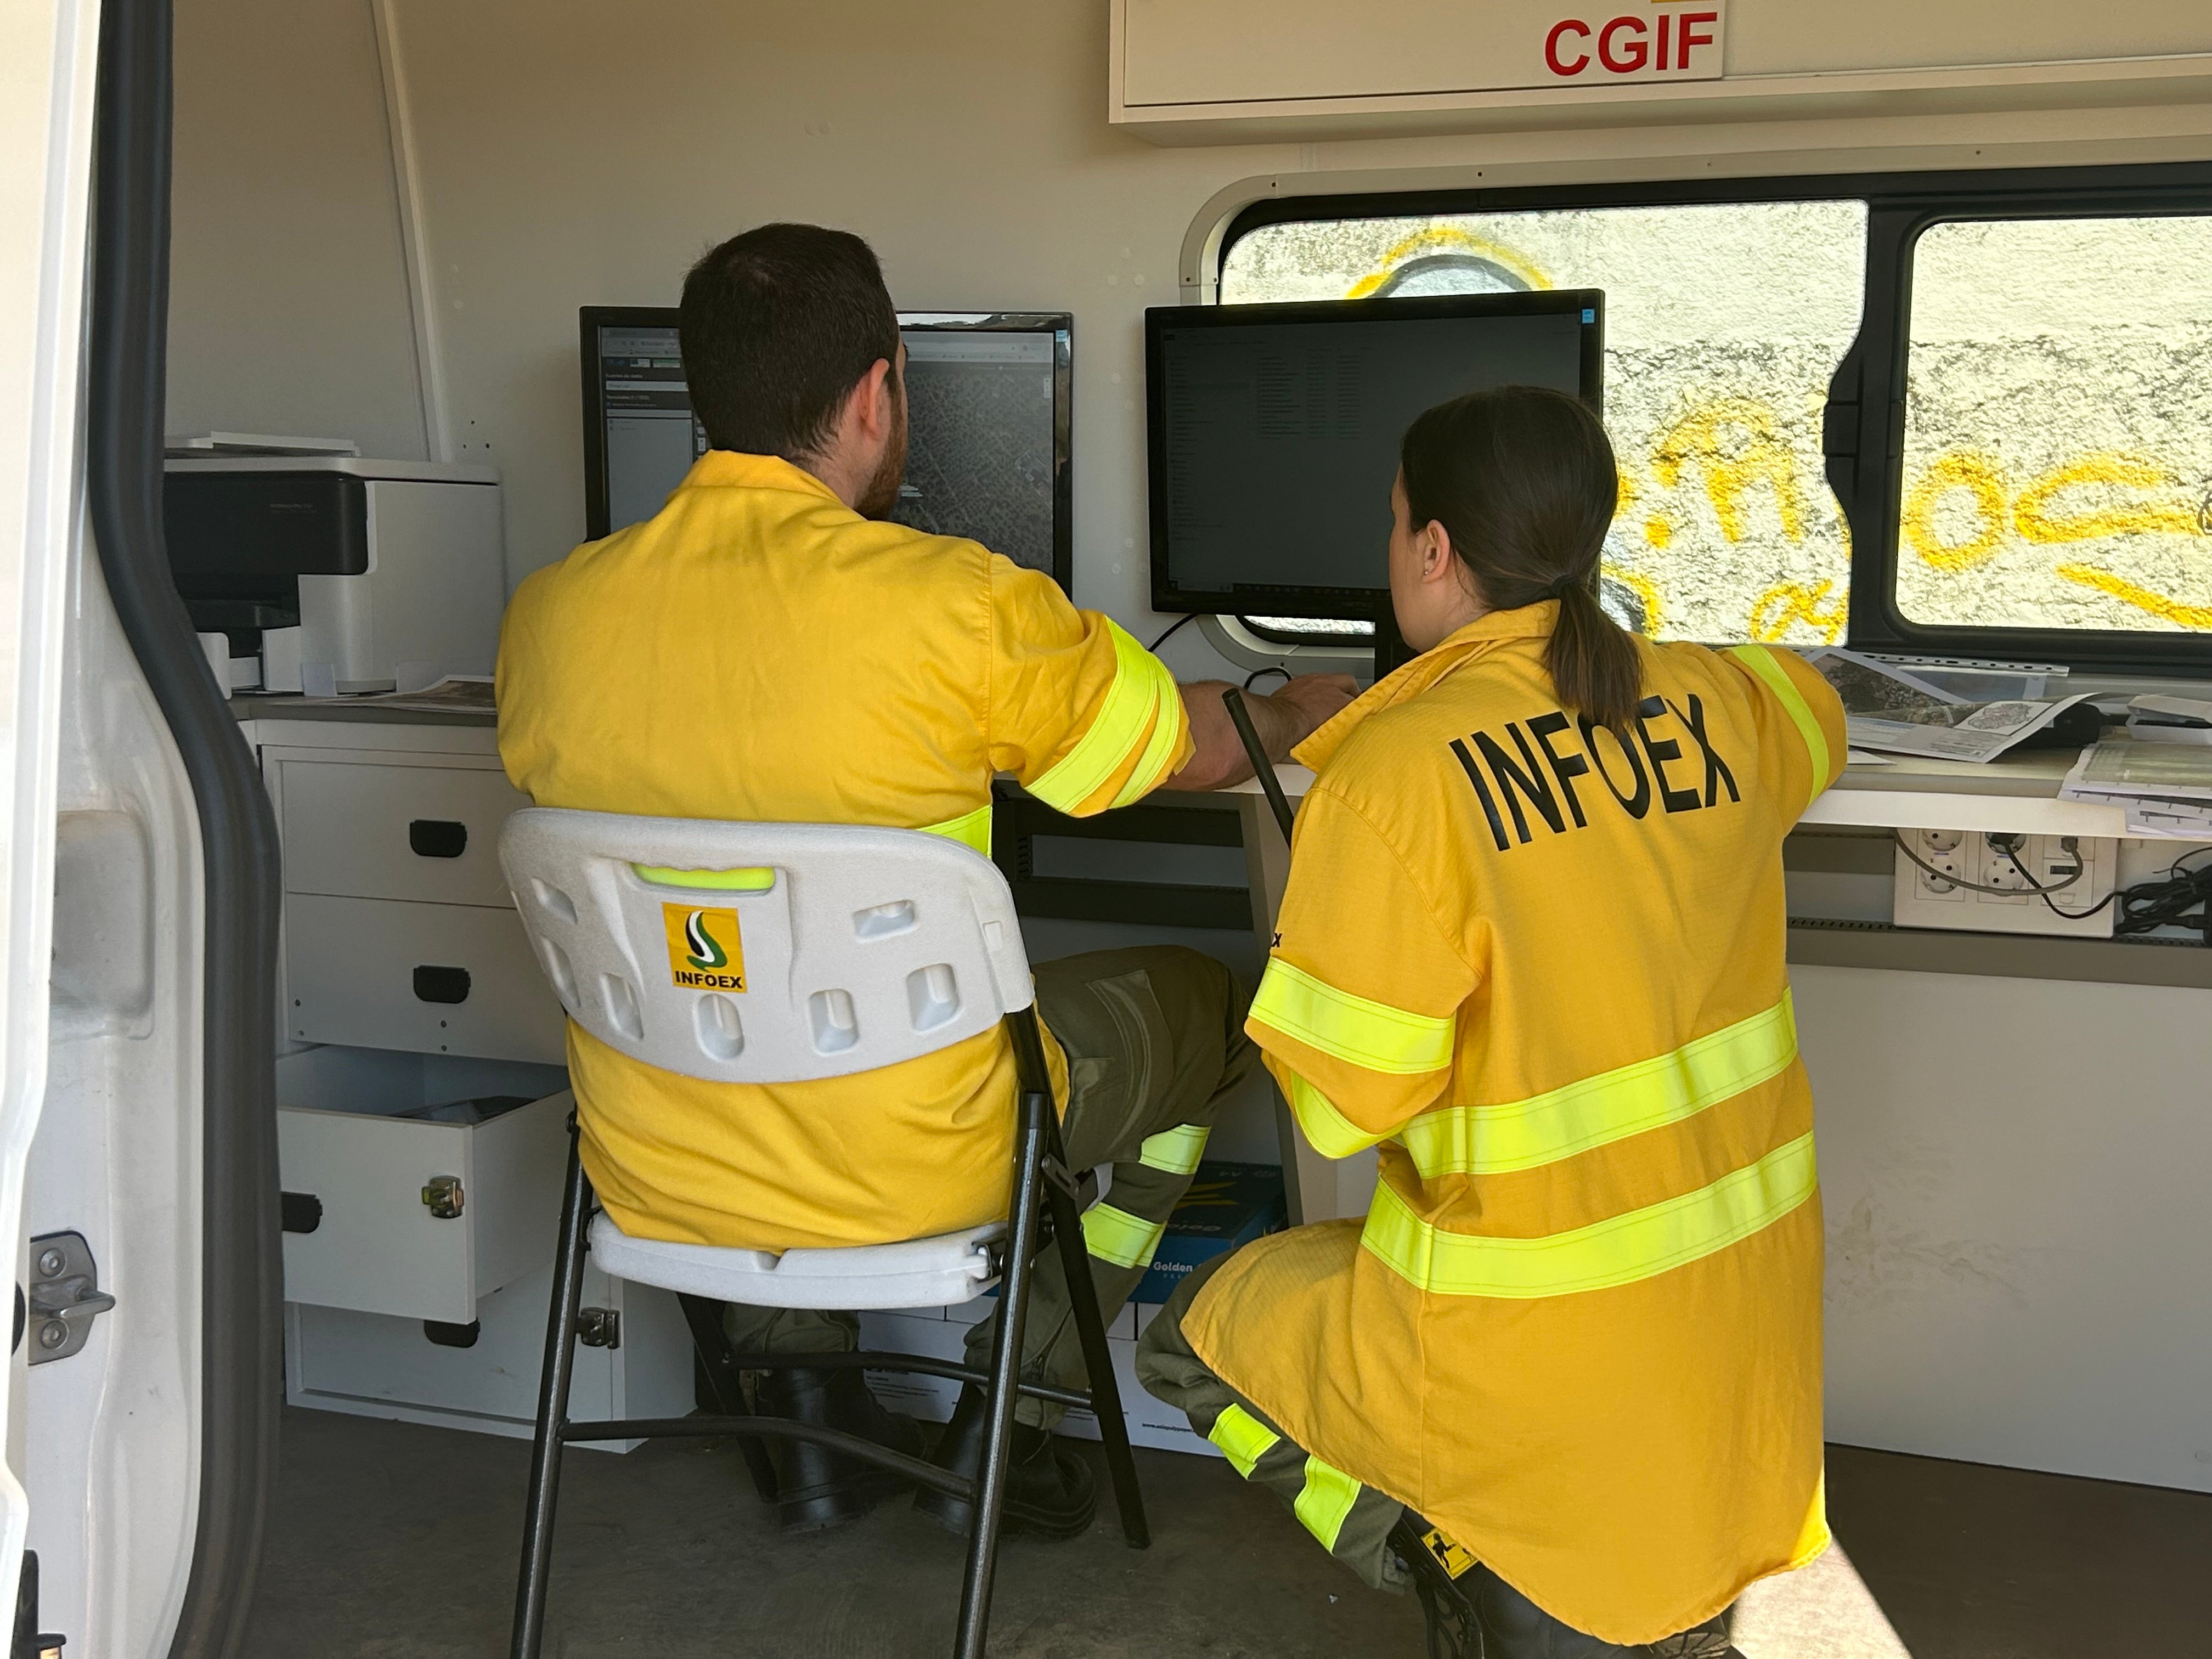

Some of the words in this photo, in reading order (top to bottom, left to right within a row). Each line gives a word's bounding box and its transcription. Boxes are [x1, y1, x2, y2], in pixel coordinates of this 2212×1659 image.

[1544, 12, 1718, 76] CGIF
[1448, 693, 1741, 851] INFOEX
[675, 970, 743, 989] INFOEX
[1153, 1261, 1193, 1272] Golden
